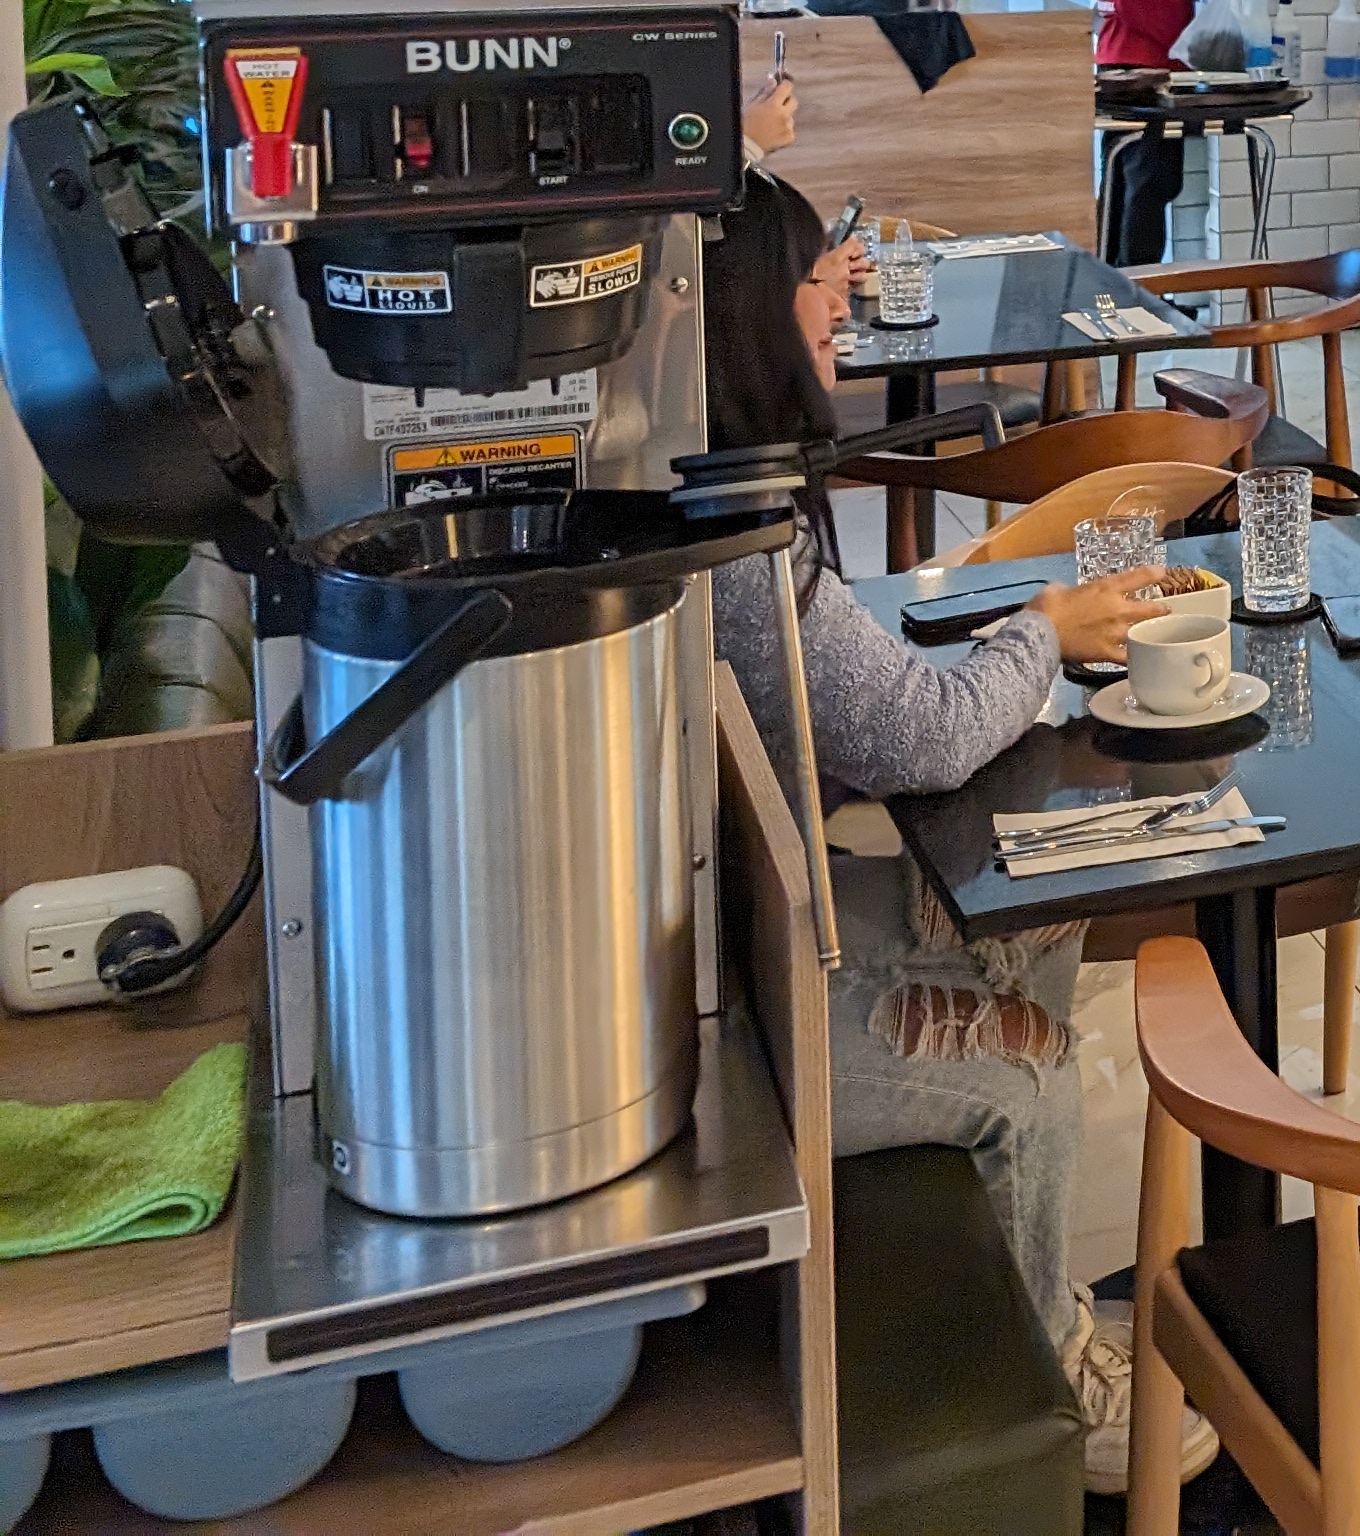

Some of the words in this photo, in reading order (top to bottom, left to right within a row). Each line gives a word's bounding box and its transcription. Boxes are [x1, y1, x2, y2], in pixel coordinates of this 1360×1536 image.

[664, 31, 718, 41] SERIES
[675, 156, 708, 166] READY
[539, 175, 568, 185] START
[588, 271, 637, 294] SLOWLY
[377, 289, 434, 302] HOT
[379, 300, 436, 310] LIQUID
[459, 443, 542, 462] WARNING
[527, 461, 572, 473] DECANTER
